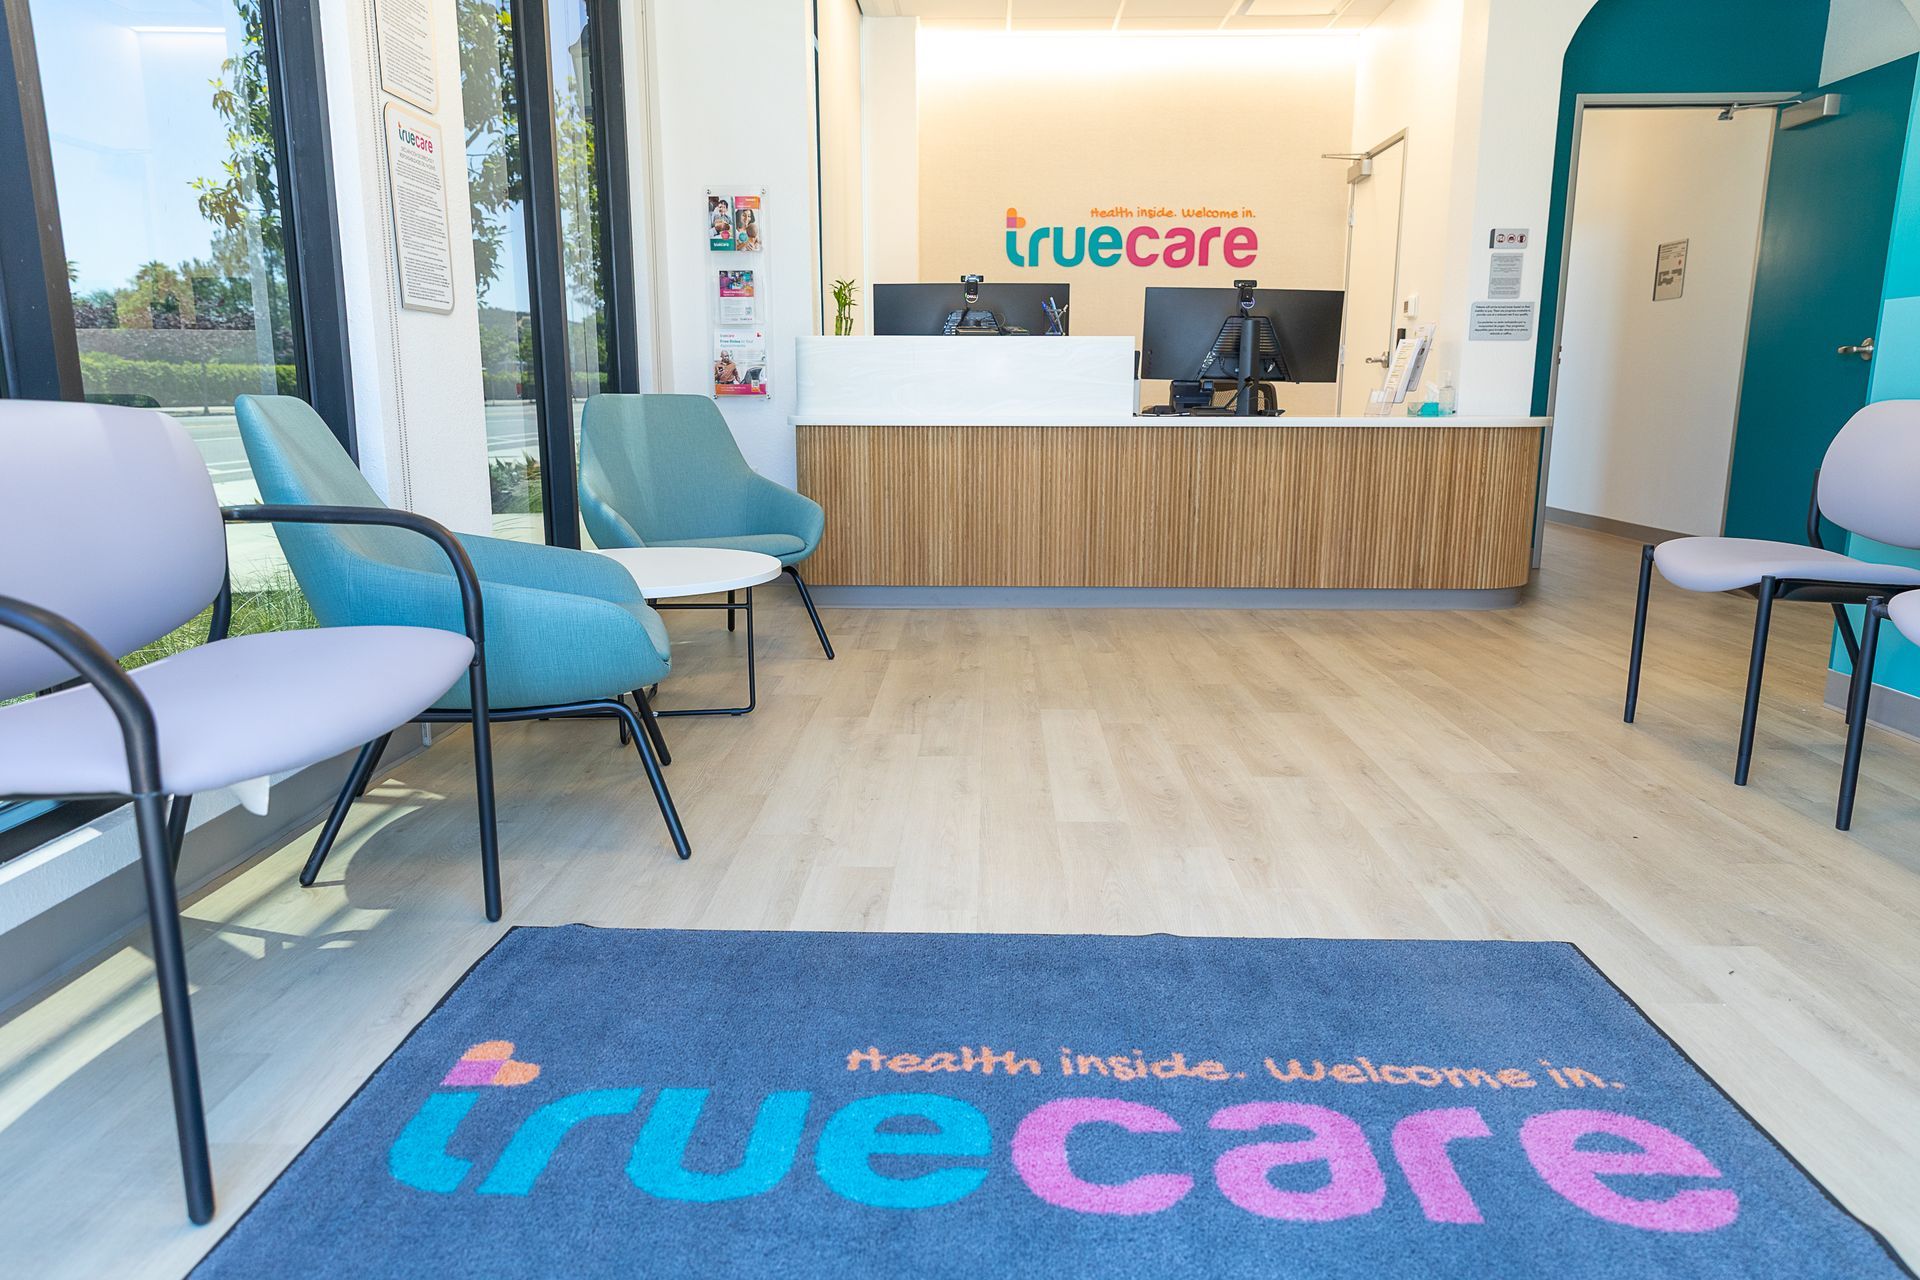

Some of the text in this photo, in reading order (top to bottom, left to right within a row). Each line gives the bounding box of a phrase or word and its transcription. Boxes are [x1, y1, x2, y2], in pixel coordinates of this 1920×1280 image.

[397, 121, 434, 154] truecare
[1091, 207, 1256, 219] Health inside. Welcome in.
[1006, 208, 1258, 268] truecare
[848, 1048, 1625, 1089] Health inside. Welcome in.
[387, 1041, 1739, 1233] truecare
